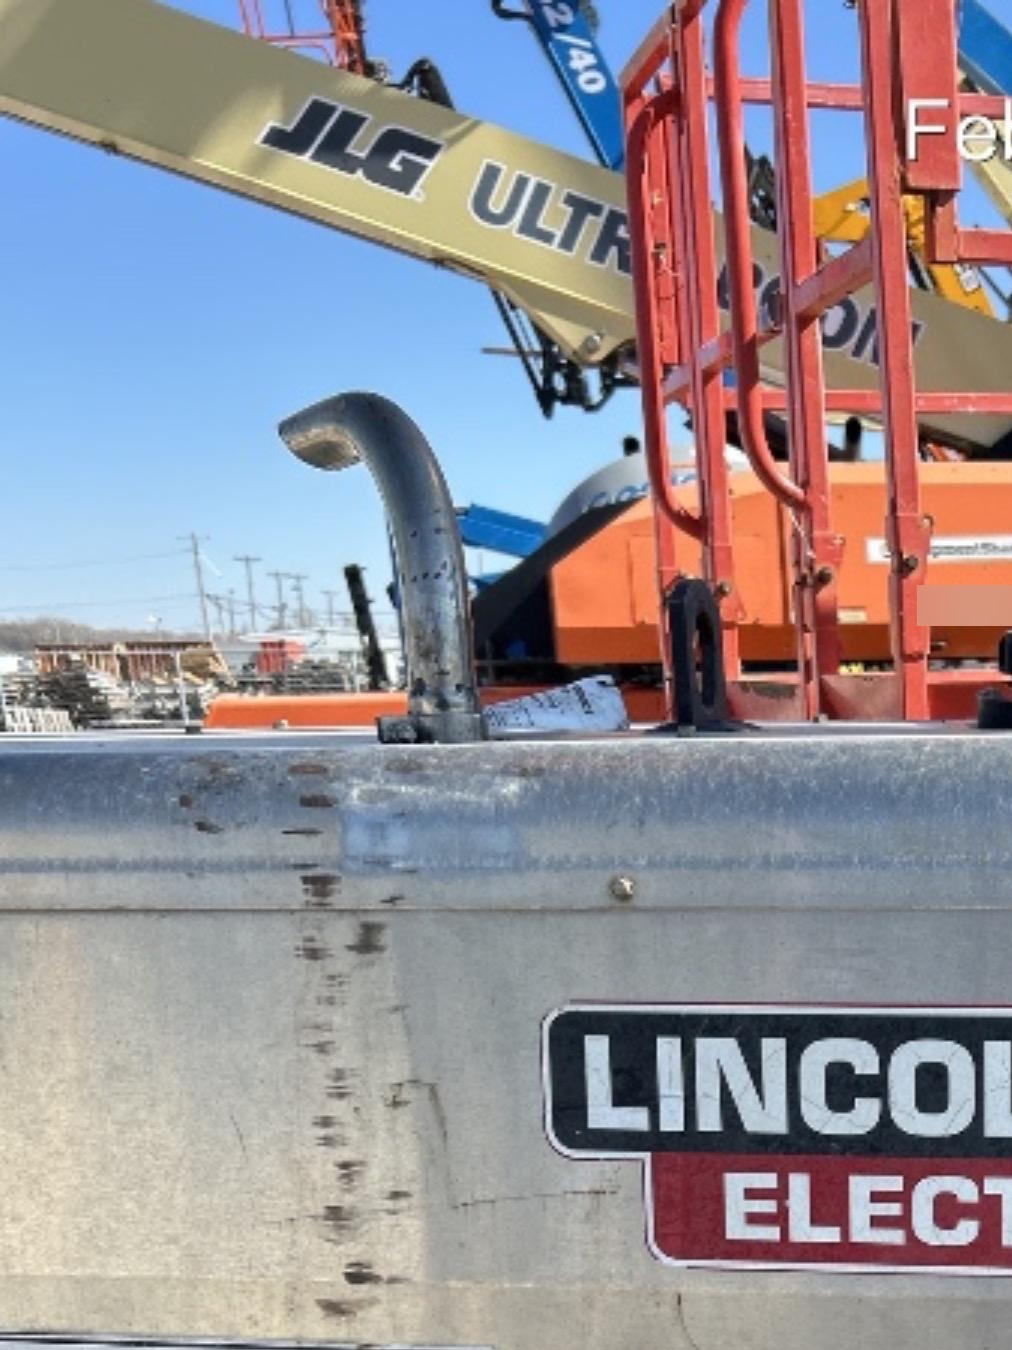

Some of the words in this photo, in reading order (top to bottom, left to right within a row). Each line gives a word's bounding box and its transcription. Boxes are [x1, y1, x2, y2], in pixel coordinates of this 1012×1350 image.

[535, 0, 607, 94] 2/40
[257, 97, 445, 200] JLG
[468, 160, 635, 273] ULTR
